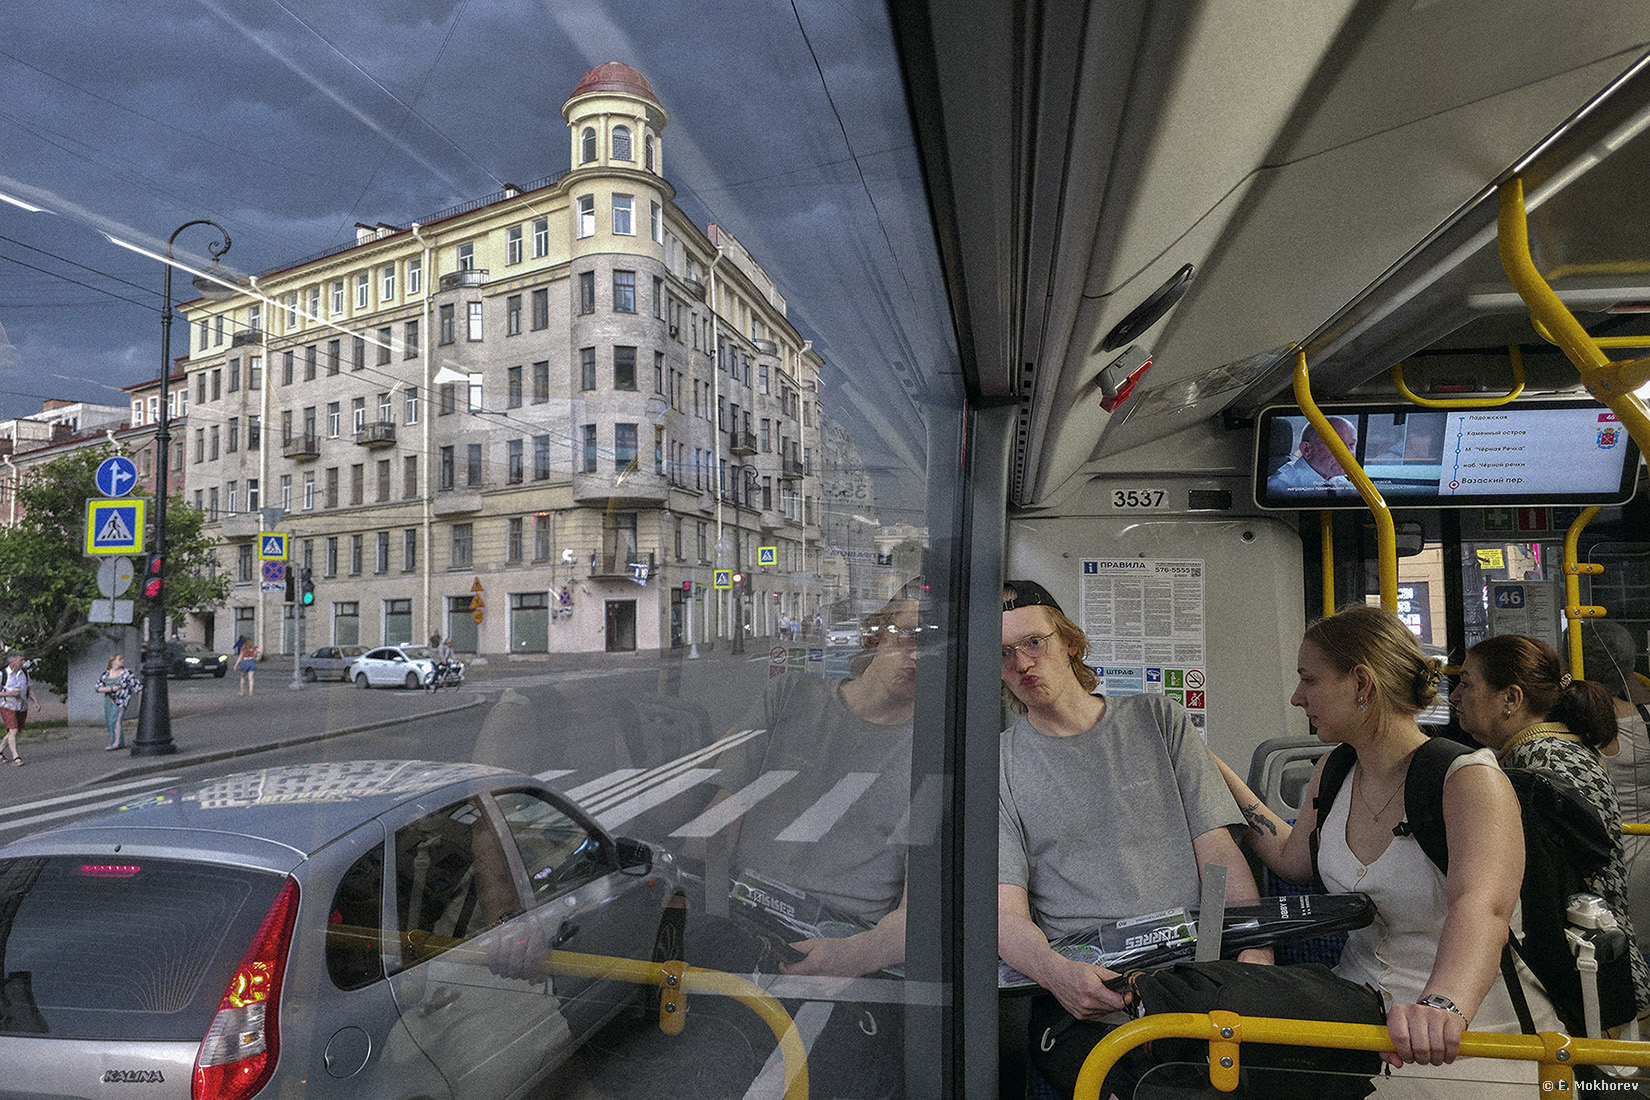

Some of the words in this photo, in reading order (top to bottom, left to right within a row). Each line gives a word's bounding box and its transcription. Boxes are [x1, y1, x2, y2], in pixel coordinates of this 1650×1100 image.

[1113, 490, 1165, 508] 3537
[1100, 561, 1146, 569] ПРАВИЛА
[1499, 591, 1521, 605] 46
[1125, 928, 1180, 950] TORRES
[104, 1069, 165, 1083] KALINA
